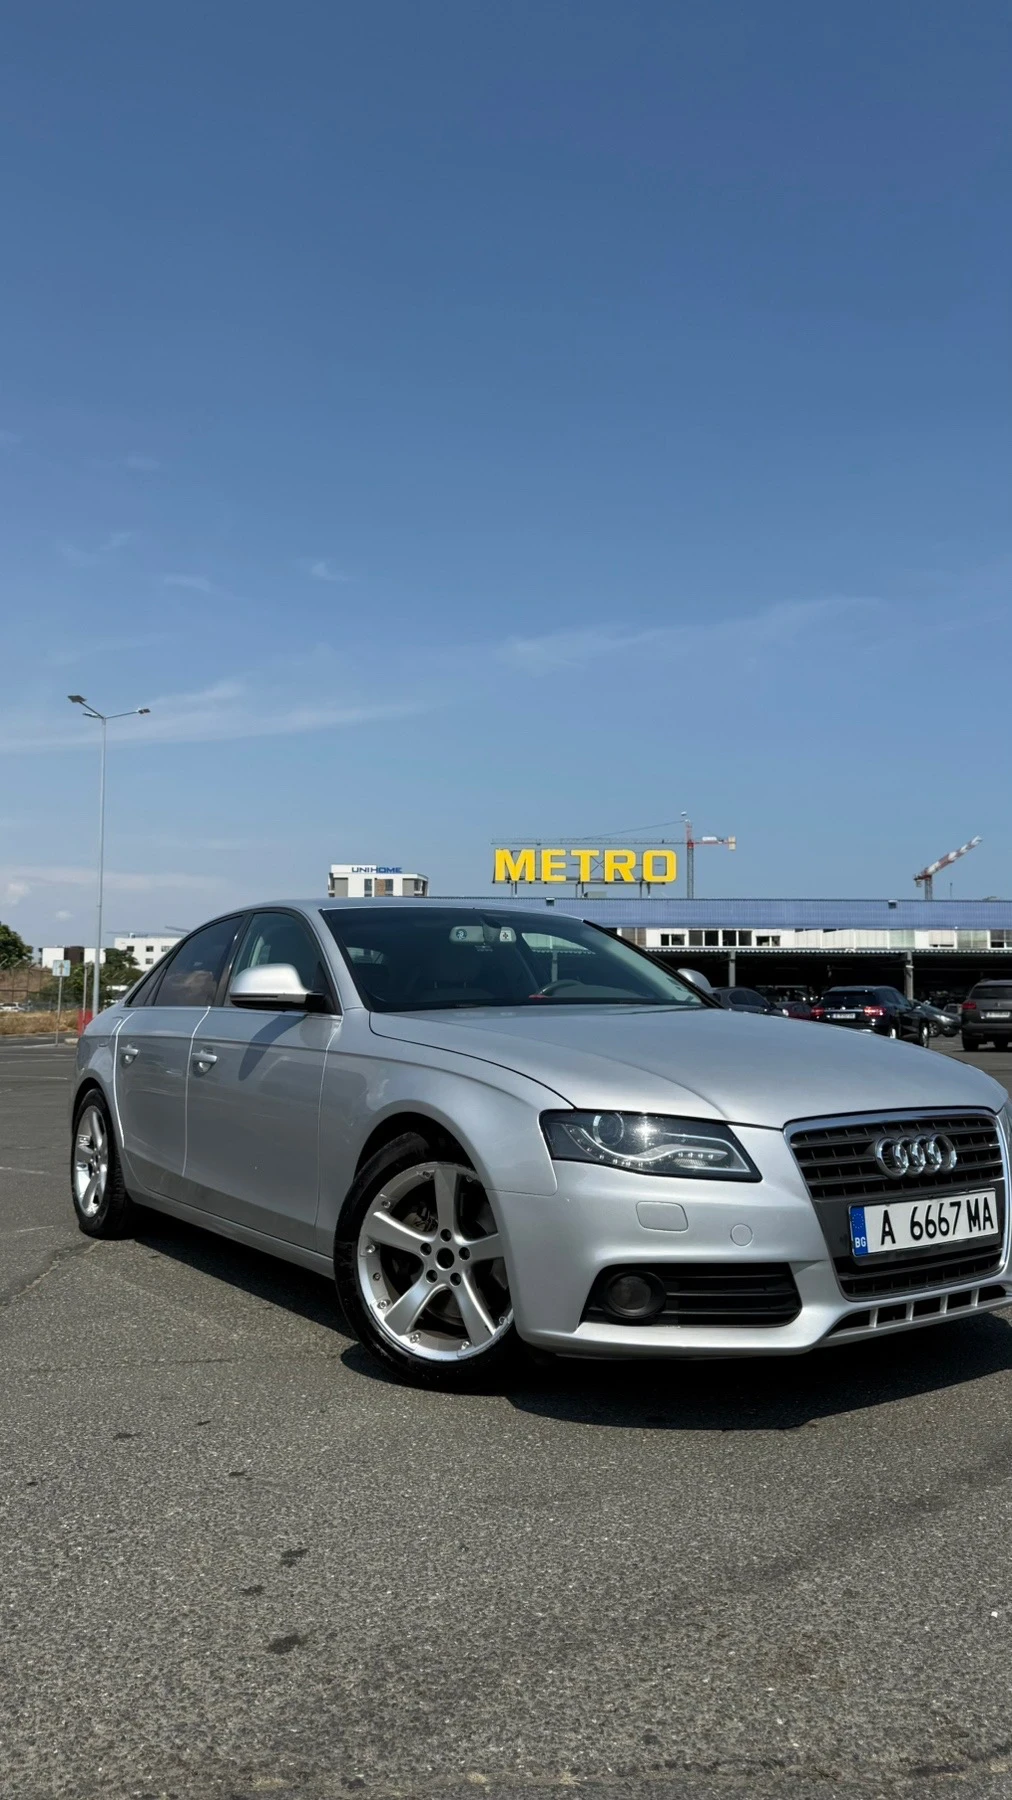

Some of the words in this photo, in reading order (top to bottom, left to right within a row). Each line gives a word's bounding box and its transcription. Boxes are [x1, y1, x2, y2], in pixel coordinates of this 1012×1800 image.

[494, 847, 677, 883] METRO
[880, 1209, 896, 1245] A
[909, 1200, 962, 1241] 6667
[966, 1196, 994, 1233] MA
[855, 1237, 867, 1248] BG
